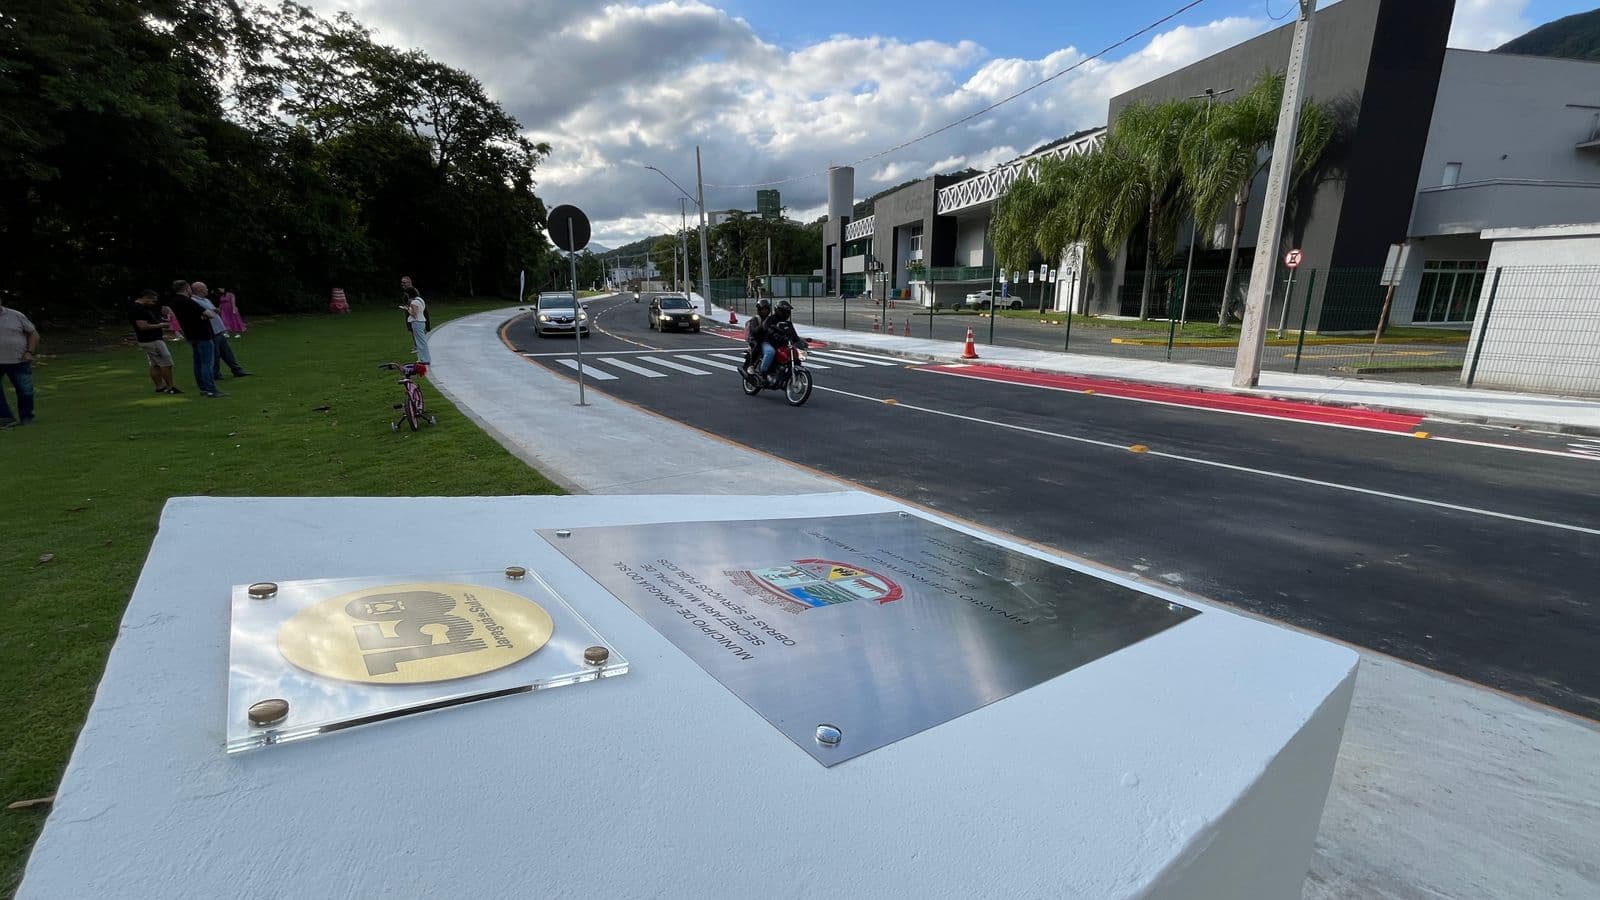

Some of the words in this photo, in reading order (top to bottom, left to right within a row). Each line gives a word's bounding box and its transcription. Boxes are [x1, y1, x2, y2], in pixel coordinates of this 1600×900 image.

[612, 561, 632, 571] SUL
[625, 571, 644, 580] DO
[657, 559, 698, 584] PÚBLICOS
[640, 581, 683, 609] JARAGUÁ
[653, 572, 701, 602] MUNICIPAL
[697, 584, 748, 614] SERVIÇOS
[469, 600, 485, 612] Sul
[676, 609, 696, 619] DE
[345, 591, 487, 675] 150
[479, 616, 512, 648] Jaraguá
[697, 602, 765, 646] SECRETARIA
[754, 620, 796, 646] OBRAS
[693, 619, 753, 660] MUNICÍPIO
